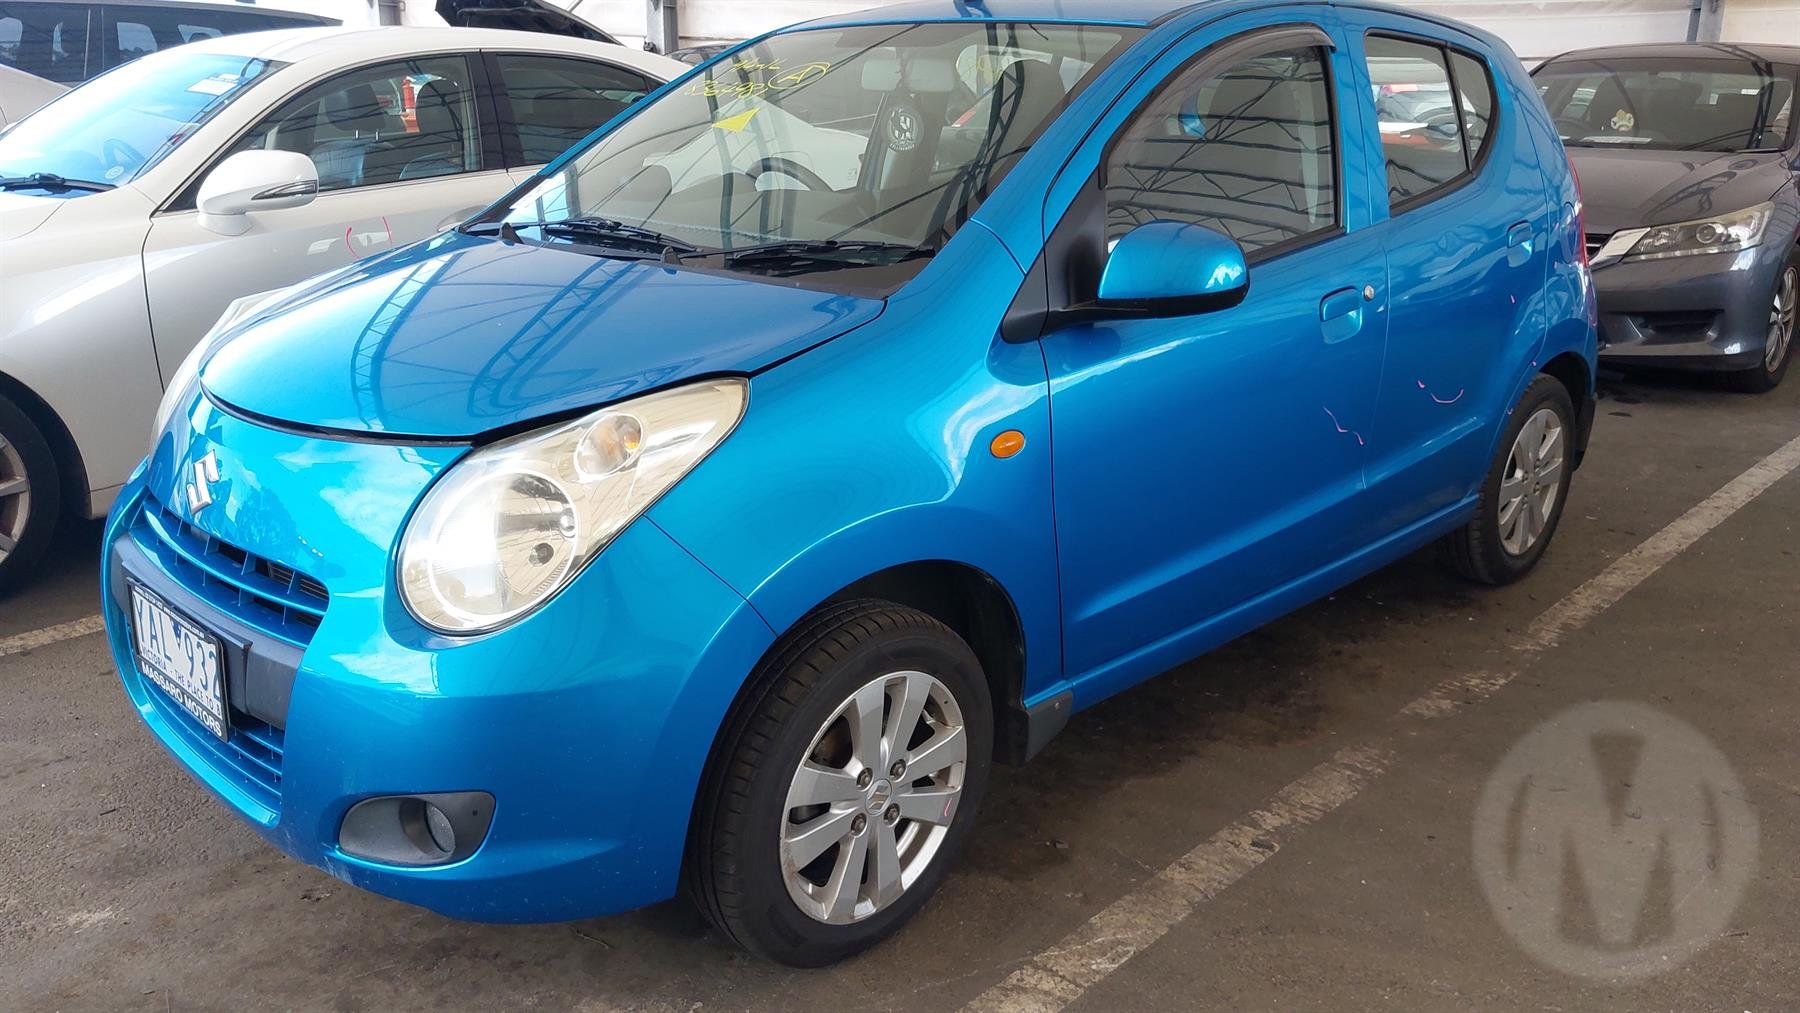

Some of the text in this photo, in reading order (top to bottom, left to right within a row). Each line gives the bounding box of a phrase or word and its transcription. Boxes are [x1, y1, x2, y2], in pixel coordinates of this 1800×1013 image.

[133, 592, 172, 662] YAL
[184, 632, 221, 700] 932
[141, 645, 167, 672] VICTORIA
[175, 668, 186, 685] THE
[187, 679, 204, 698] PLACE
[205, 693, 214, 709] TO
[142, 661, 222, 737] MASSARO MOTORS
